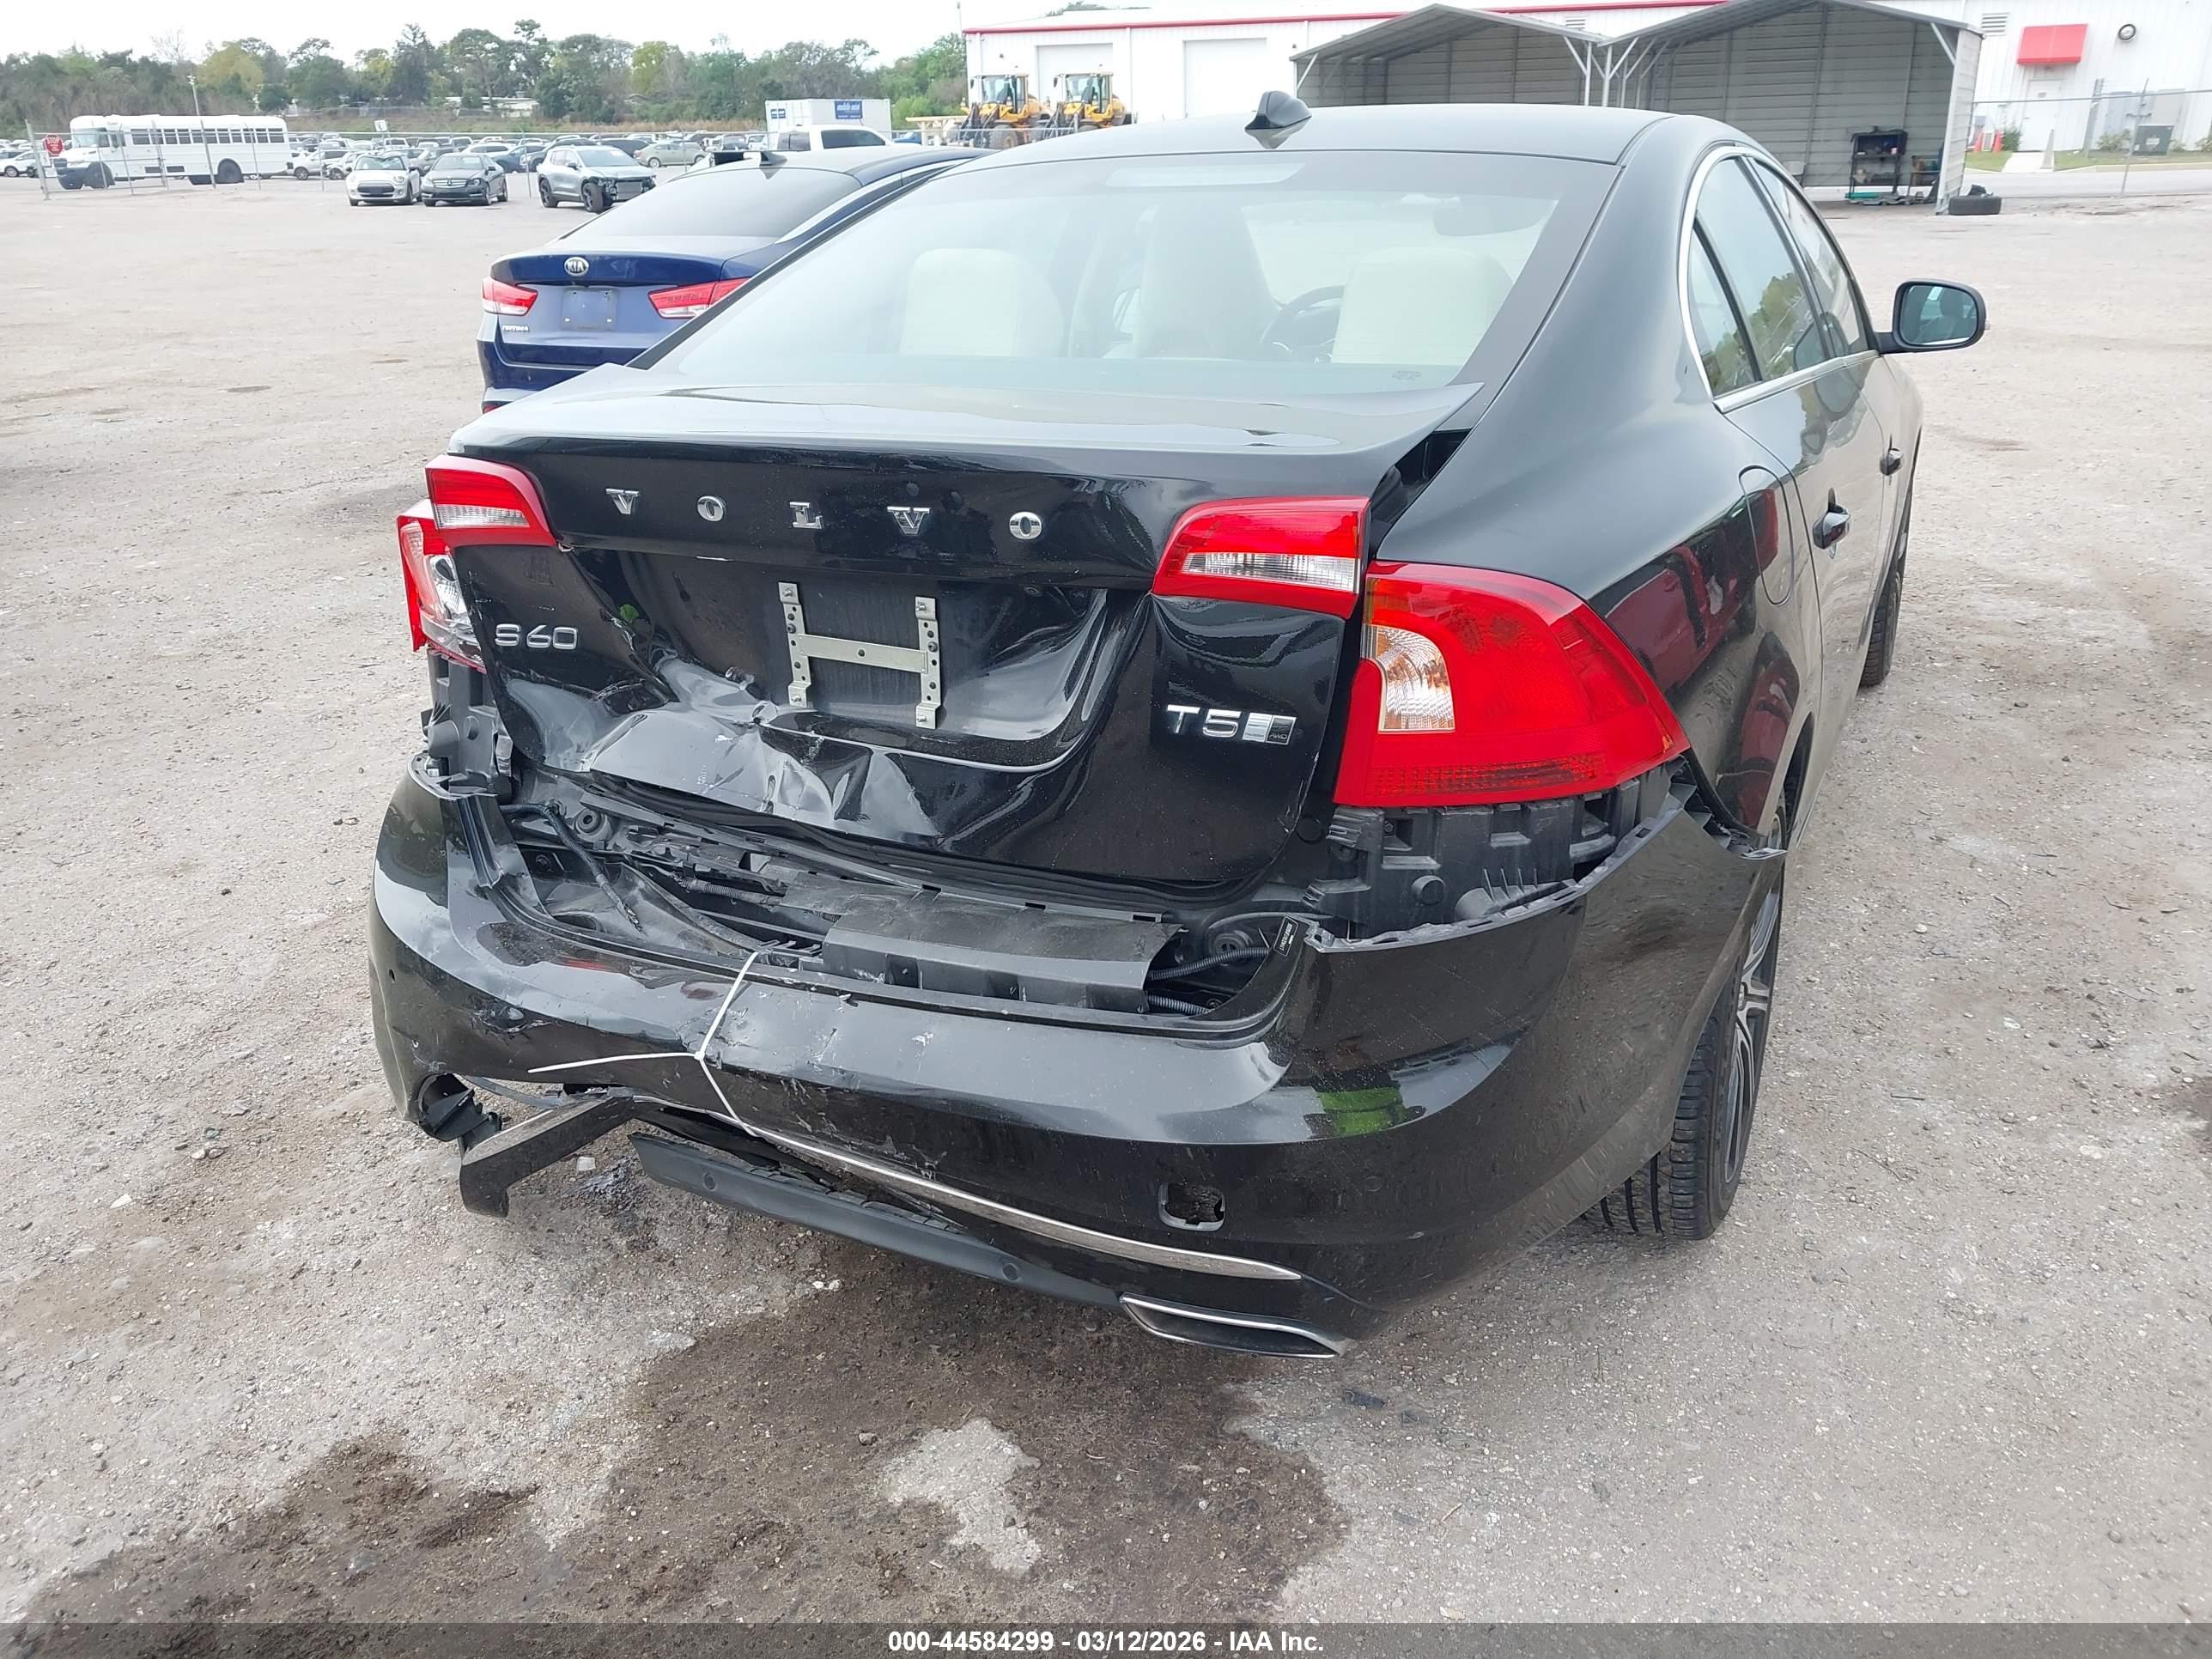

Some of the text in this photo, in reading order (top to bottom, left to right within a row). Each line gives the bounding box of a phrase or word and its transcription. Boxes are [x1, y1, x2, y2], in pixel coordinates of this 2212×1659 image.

[567, 260, 585, 273] KIA
[605, 488, 1043, 540] VOLVO
[495, 623, 577, 649] S60
[1167, 704, 1242, 738] T5
